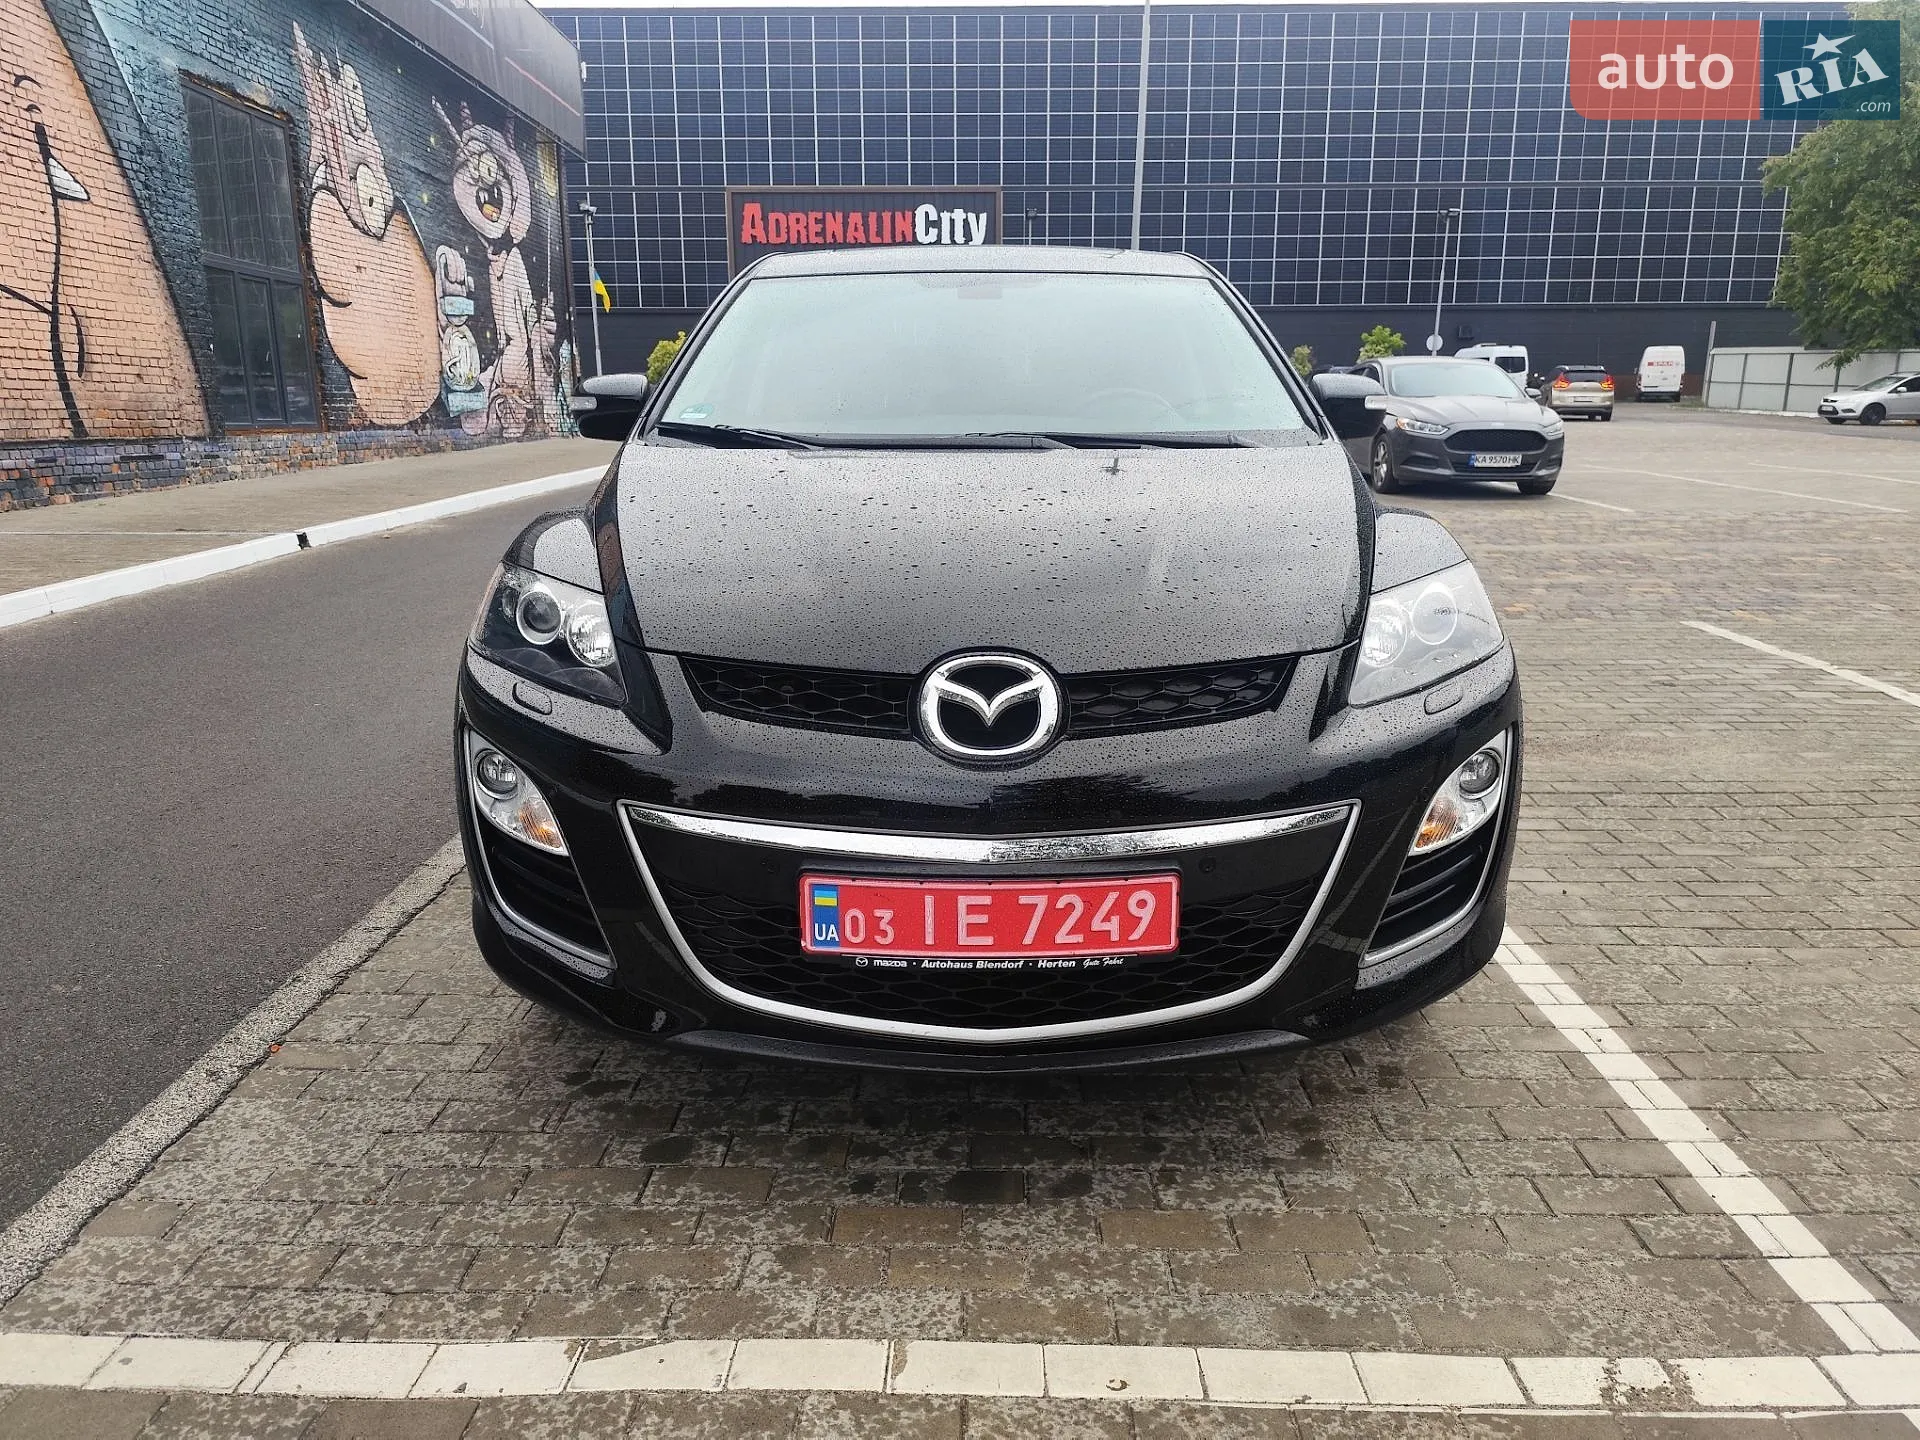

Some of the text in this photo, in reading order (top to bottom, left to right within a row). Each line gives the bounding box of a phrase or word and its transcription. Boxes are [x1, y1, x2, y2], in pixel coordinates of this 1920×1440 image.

[844, 889, 1157, 946] 03 IE 7249
[814, 923, 840, 942] UA
[921, 959, 973, 969] Autohaus
[976, 959, 1024, 969] Blendorf
[1037, 959, 1076, 969] Herten
